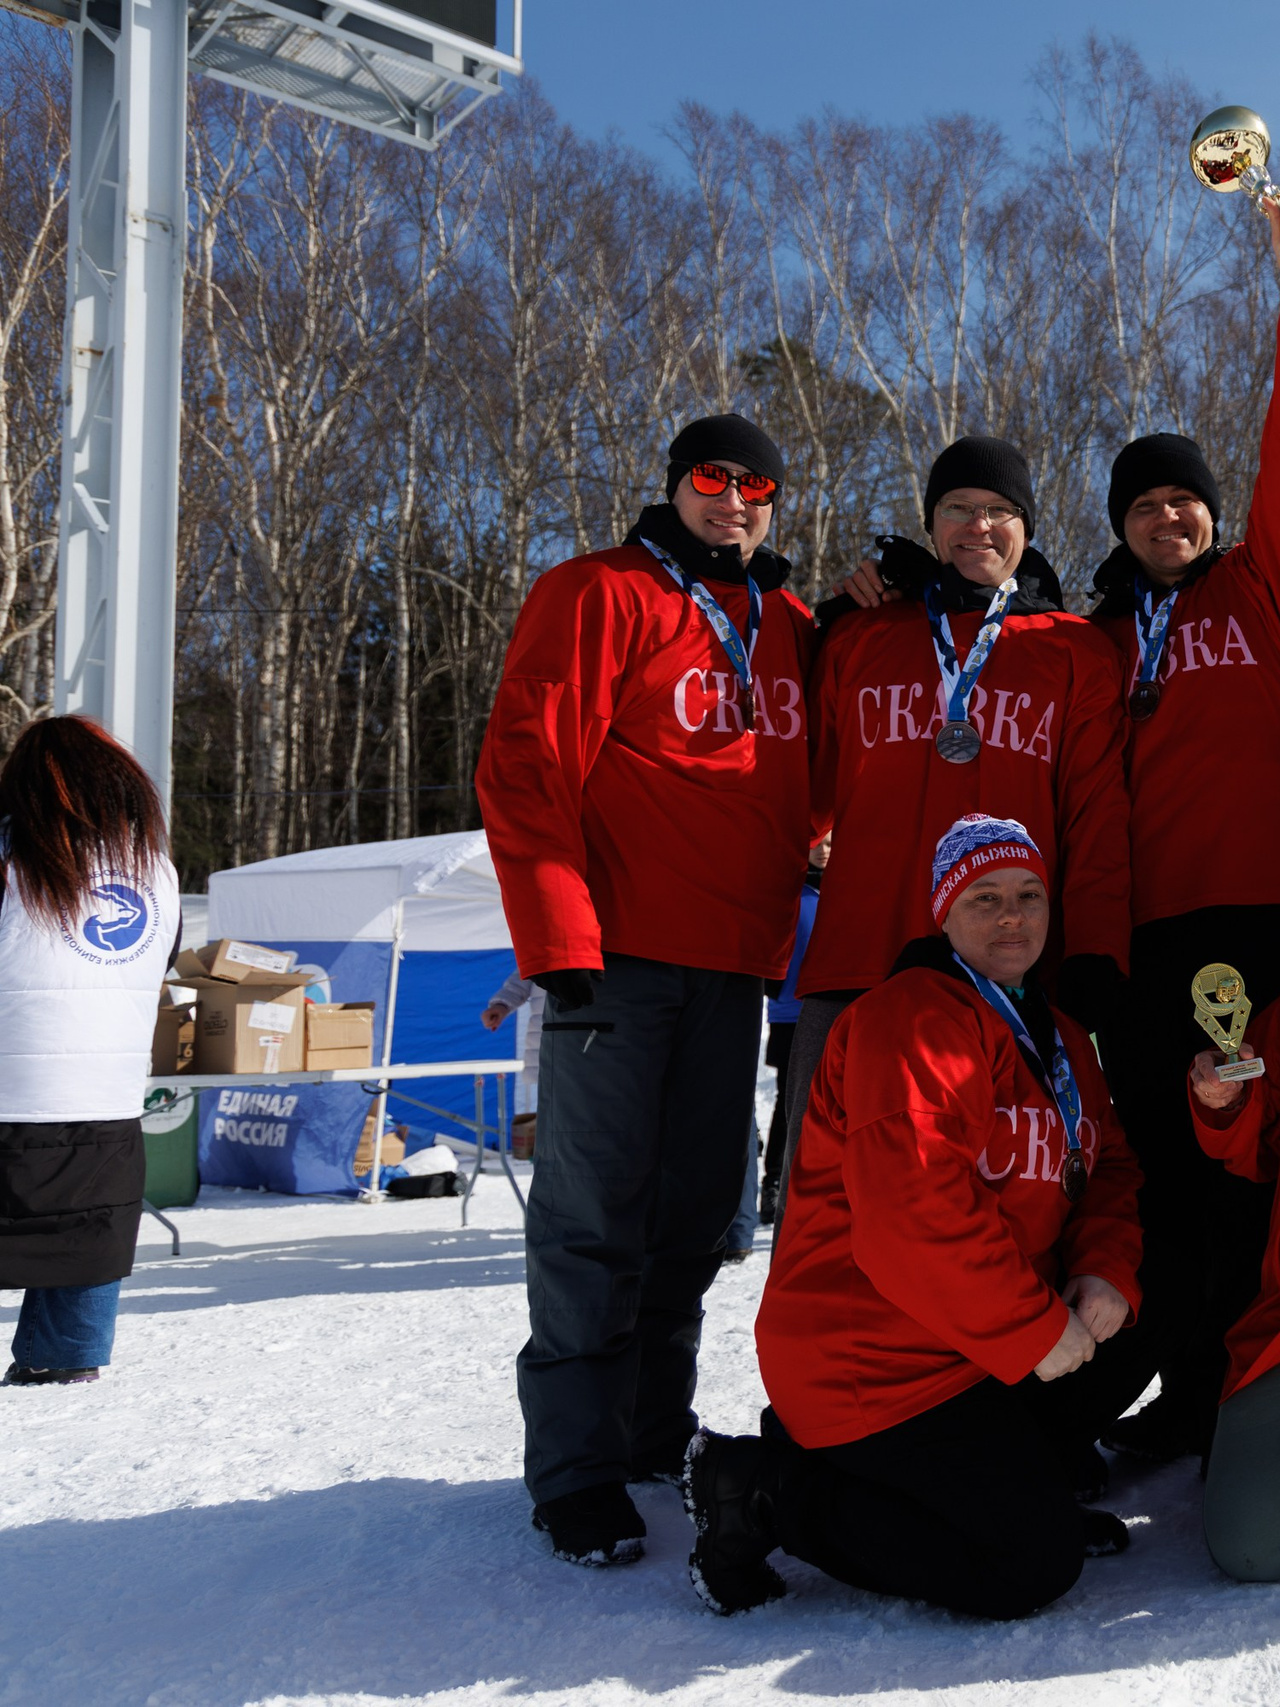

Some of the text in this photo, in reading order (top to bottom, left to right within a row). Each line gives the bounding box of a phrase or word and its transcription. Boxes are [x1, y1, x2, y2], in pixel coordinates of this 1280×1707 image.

[690, 585, 744, 663] ОБЛАСТЬ
[959, 622, 995, 694] ОБЛАСТЬ
[674, 667, 807, 740] СКАЗ
[971, 846, 1030, 869] ЛЫЖНЯ
[63, 932, 103, 965] ЕДИНОЙ
[217, 1089, 299, 1117] ЕДИНАЯ
[213, 1117, 288, 1148] РОССИЯ
